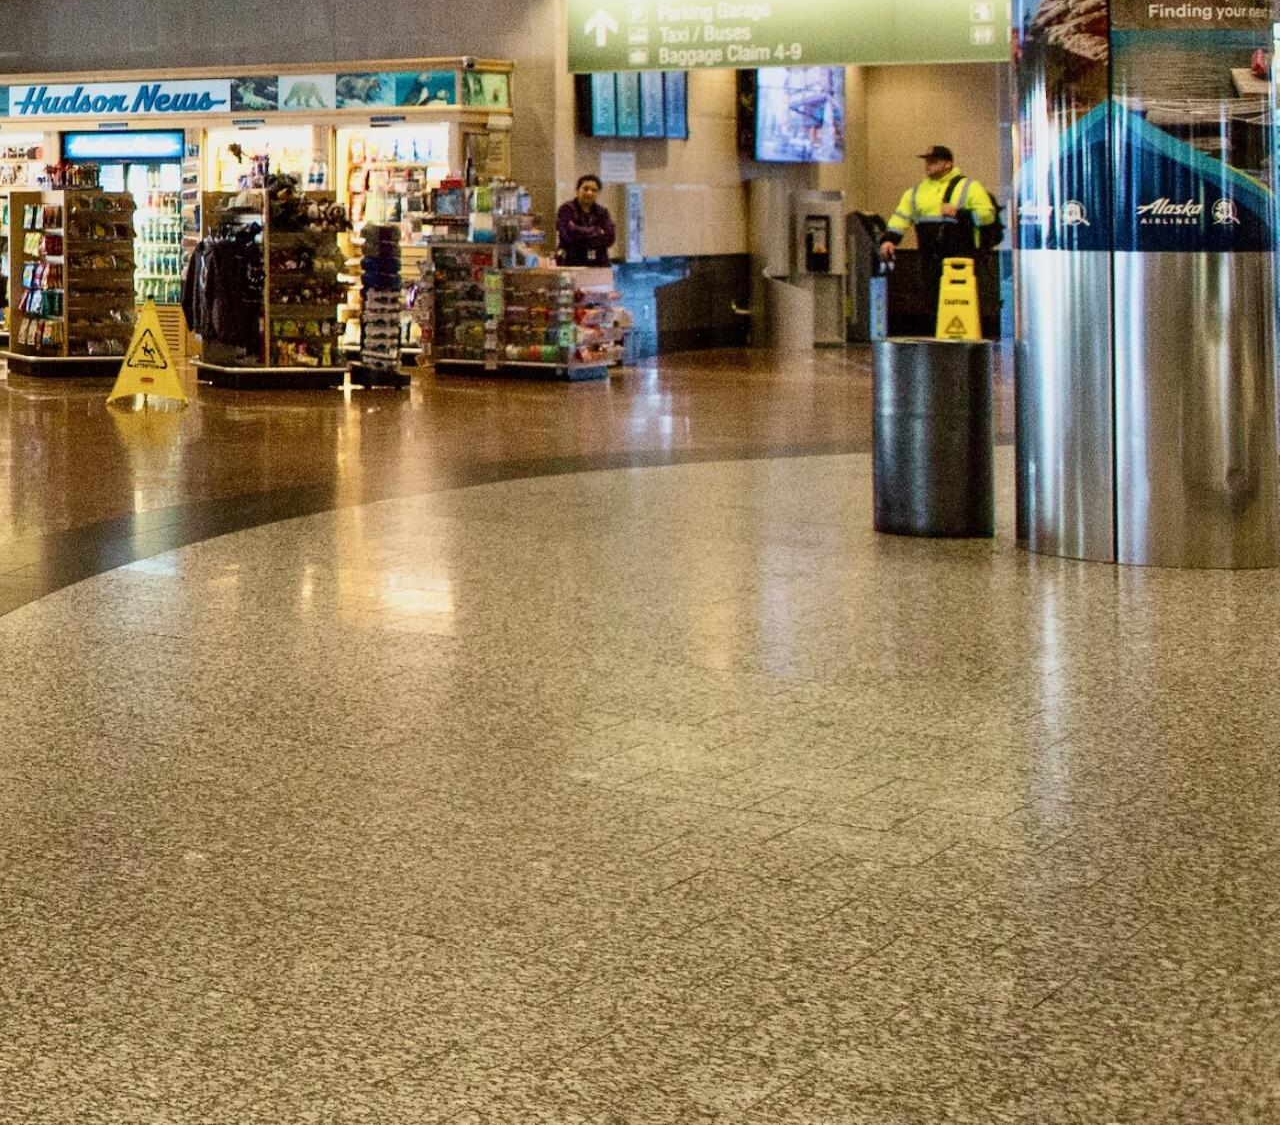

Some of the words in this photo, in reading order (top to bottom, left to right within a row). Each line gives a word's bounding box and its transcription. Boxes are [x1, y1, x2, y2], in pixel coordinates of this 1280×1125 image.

[716, 1, 771, 21] Garage
[1148, 3, 1213, 21] Finding
[1216, 7, 1246, 20] your
[659, 27, 690, 43] Taxi
[704, 25, 752, 42] Buses
[658, 47, 723, 66] Baggage
[726, 44, 771, 62] Claim
[774, 42, 803, 61] 4-9
[14, 86, 129, 115] Hudson
[131, 83, 227, 113] News
[1136, 197, 1204, 217] Alaska
